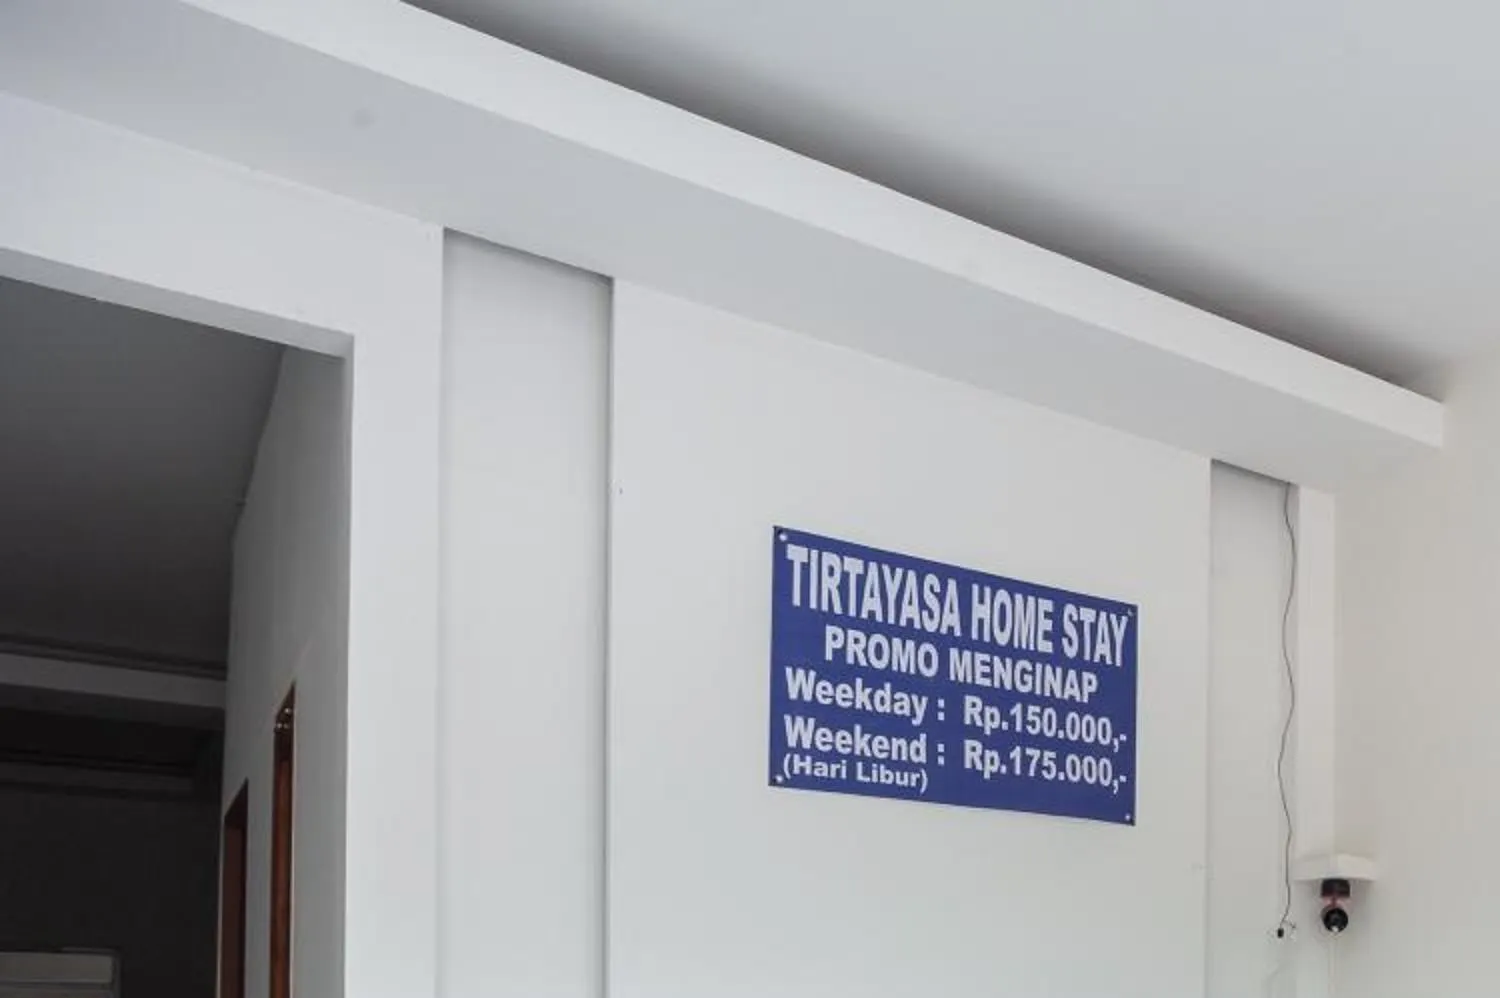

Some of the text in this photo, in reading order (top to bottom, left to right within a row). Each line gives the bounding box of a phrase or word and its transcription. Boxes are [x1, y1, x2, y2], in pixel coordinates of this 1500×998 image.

[786, 543, 1129, 667] TIRTAYASA HOME STAY
[824, 624, 1099, 703] PROMO MENGINAP
[785, 666, 928, 726] Weekday
[963, 694, 1127, 752] Rp.150.000,-
[783, 755, 929, 794] (Hari Libur)
[784, 714, 928, 764] Weekend
[963, 739, 1127, 795] Rp.175.000,-
